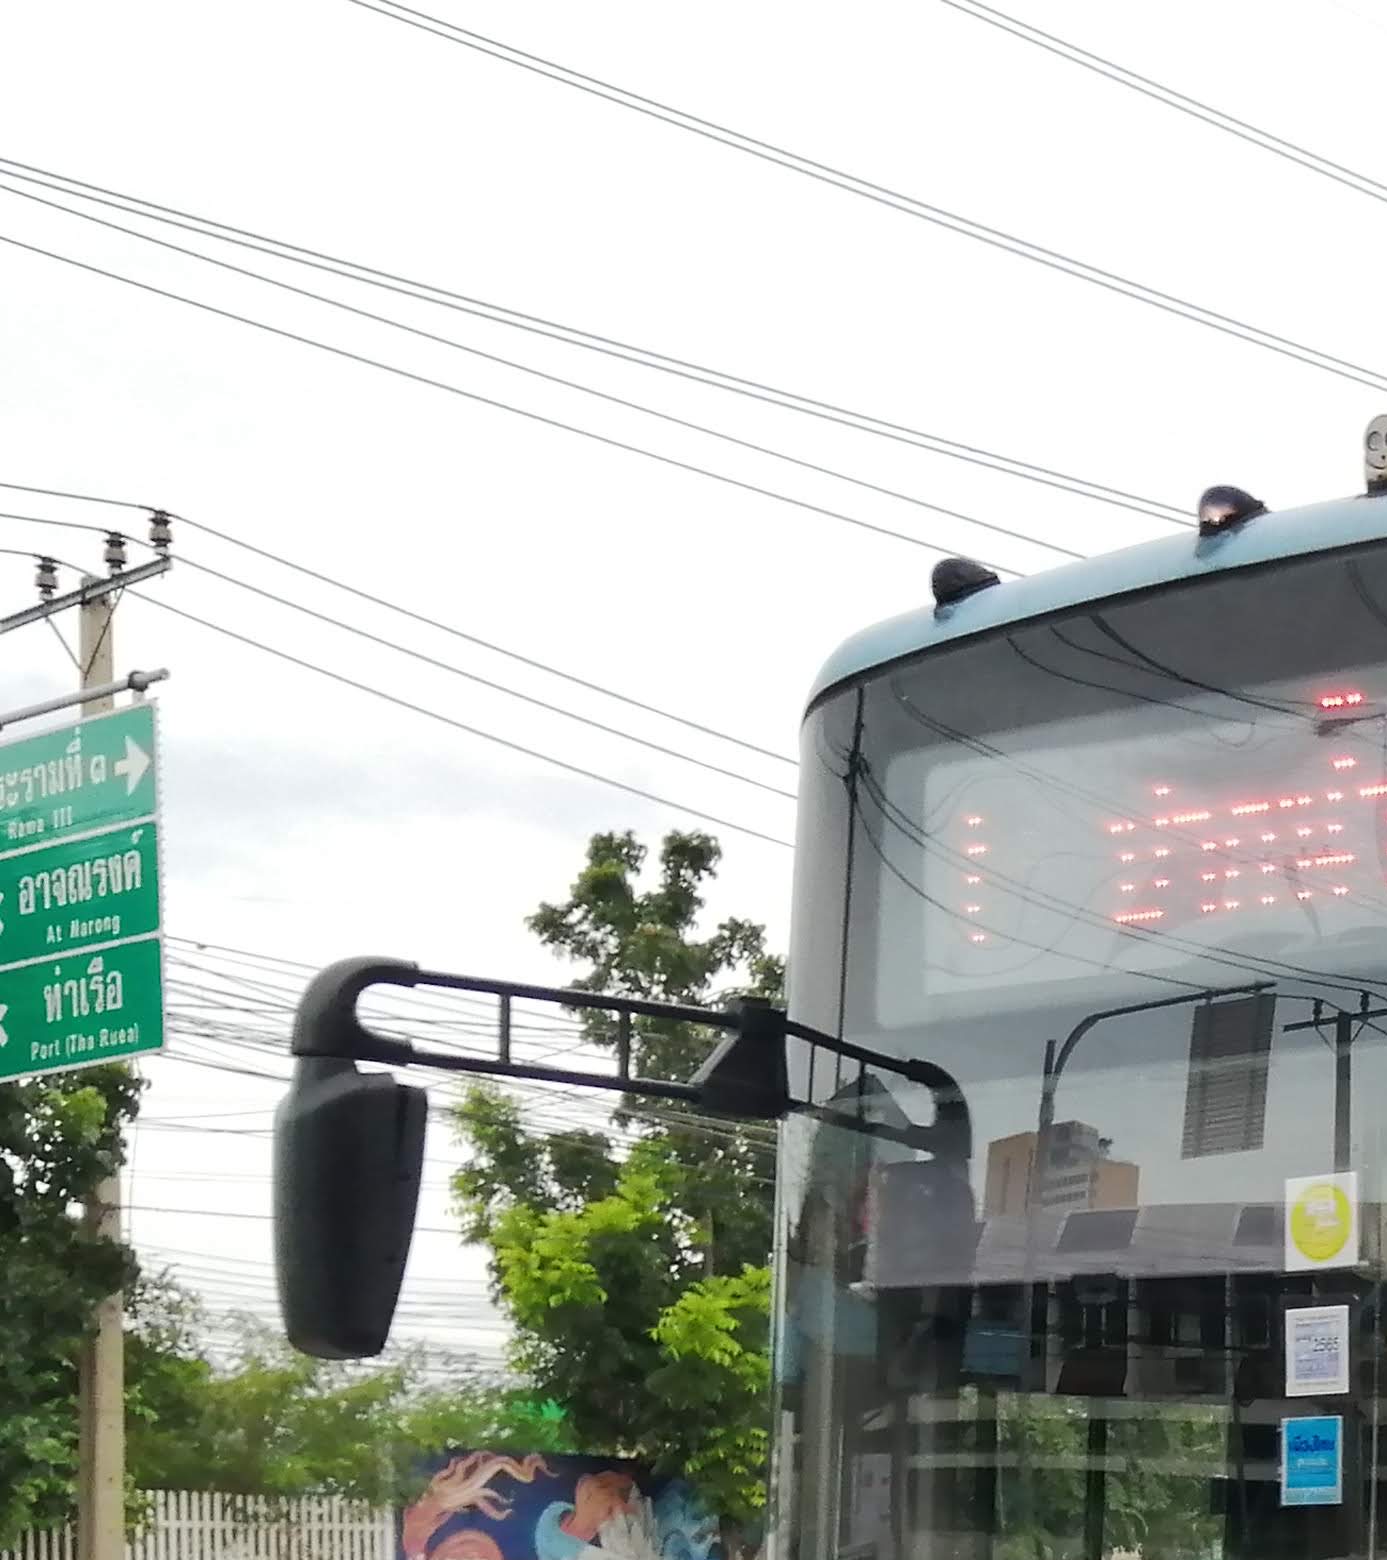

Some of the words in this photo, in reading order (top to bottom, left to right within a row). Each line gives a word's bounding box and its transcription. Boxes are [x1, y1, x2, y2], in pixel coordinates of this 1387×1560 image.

[7, 816, 45, 840] Rama
[52, 804, 73, 830] III
[18, 828, 144, 916] อาจณรงค์
[46, 924, 63, 945] At
[70, 914, 121, 939] Narong
[43, 955, 124, 1024] ท่าเรือ
[30, 1033, 61, 1062] Port
[65, 1031, 95, 1058] (Tha
[99, 1022, 140, 1050] Ruea)
